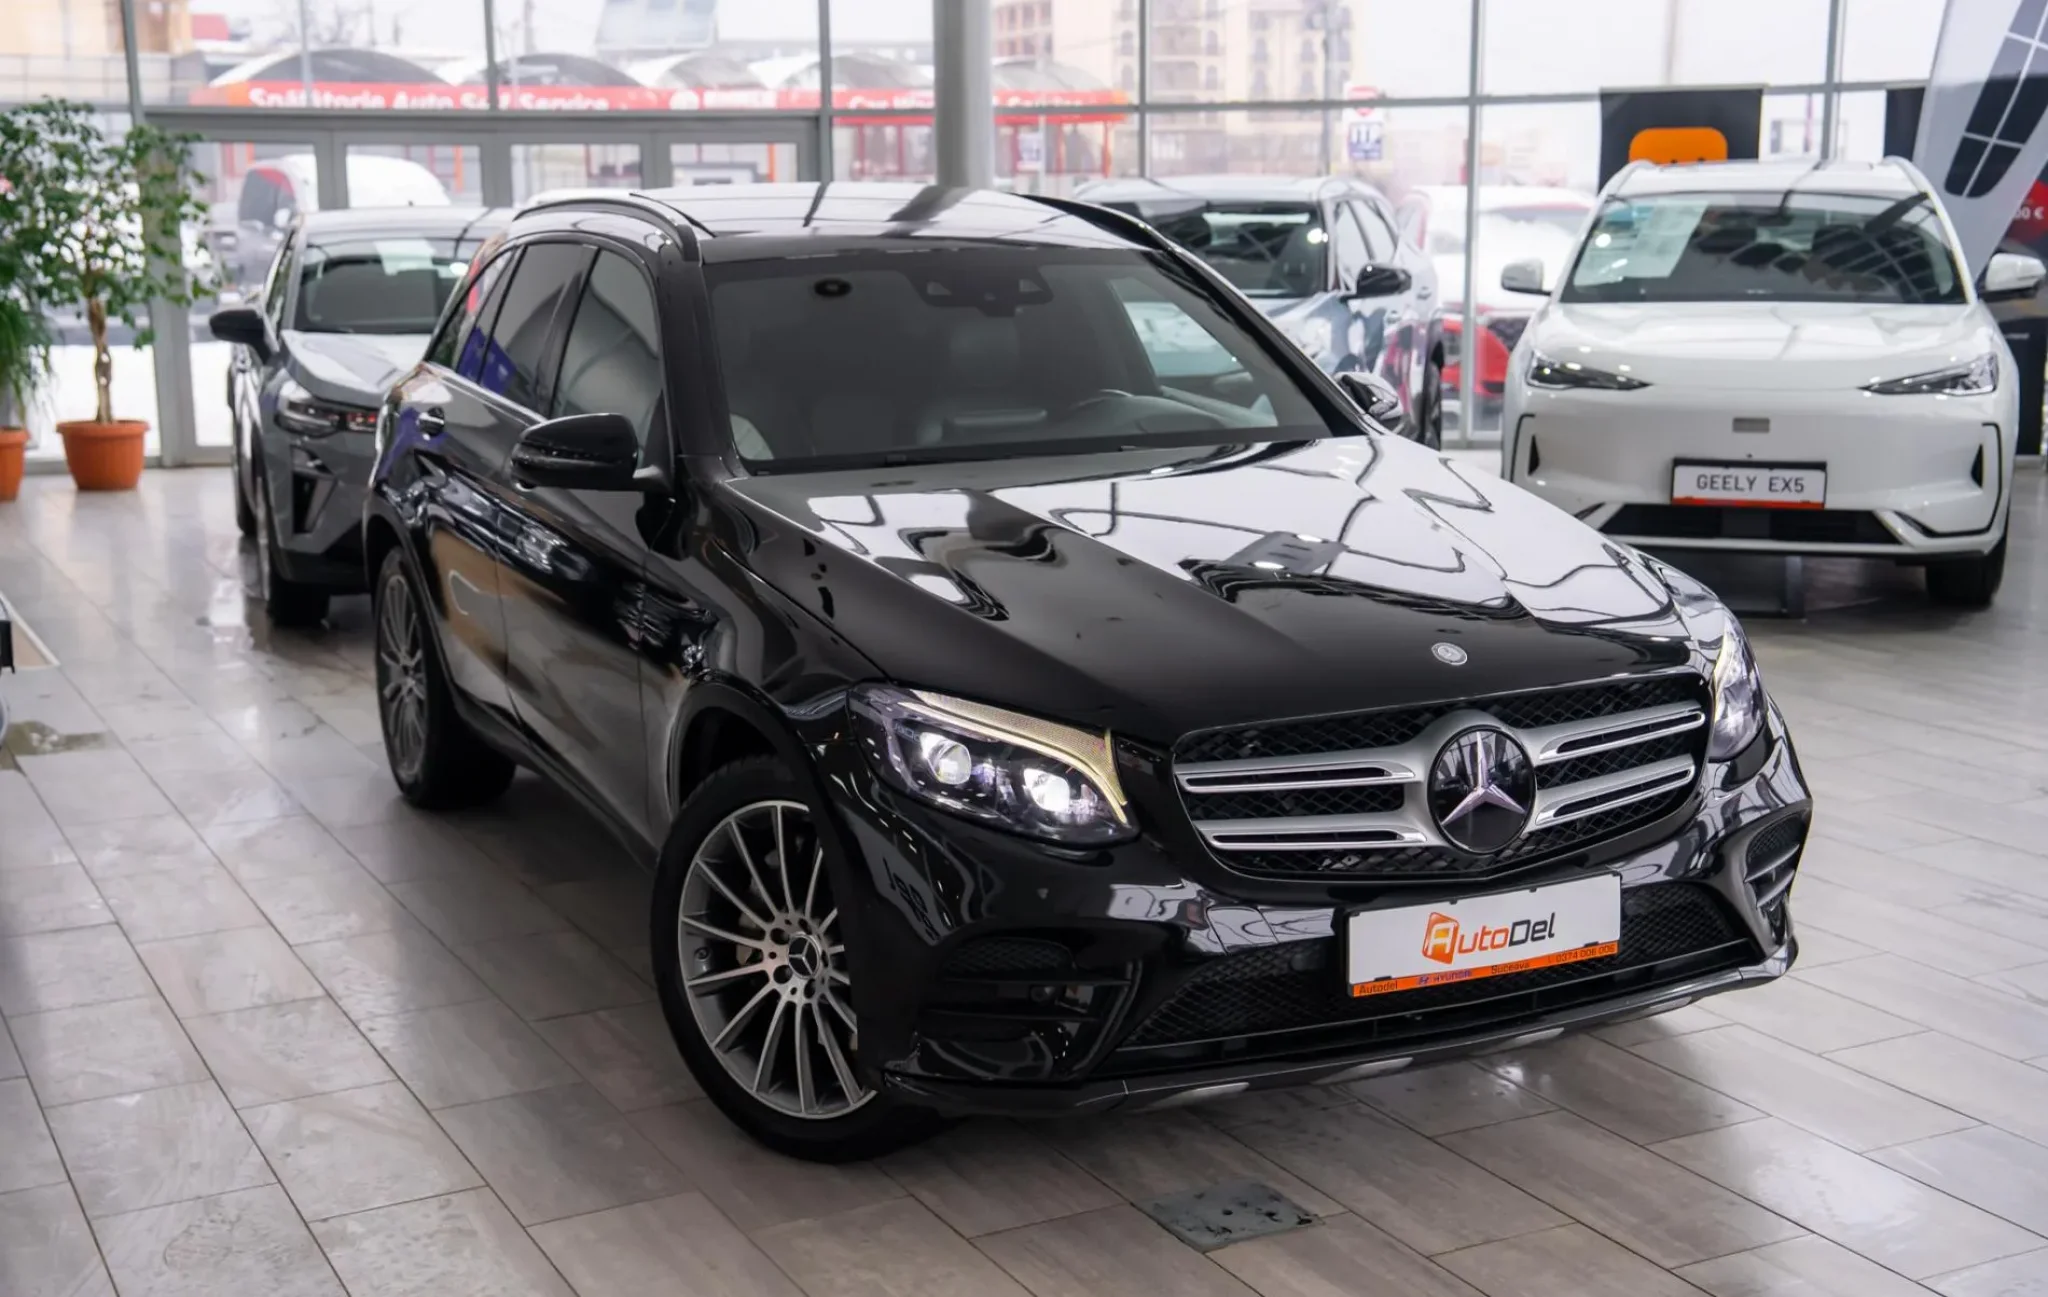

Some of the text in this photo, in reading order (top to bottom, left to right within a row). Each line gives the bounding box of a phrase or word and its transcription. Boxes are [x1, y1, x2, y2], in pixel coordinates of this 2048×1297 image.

[1696, 473, 1805, 494] GEELY EX5
[1424, 911, 1556, 961] AutoDel
[1359, 981, 1399, 995] Autodel
[1491, 961, 1531, 974] Suceava
[1555, 949, 1579, 962] 0374
